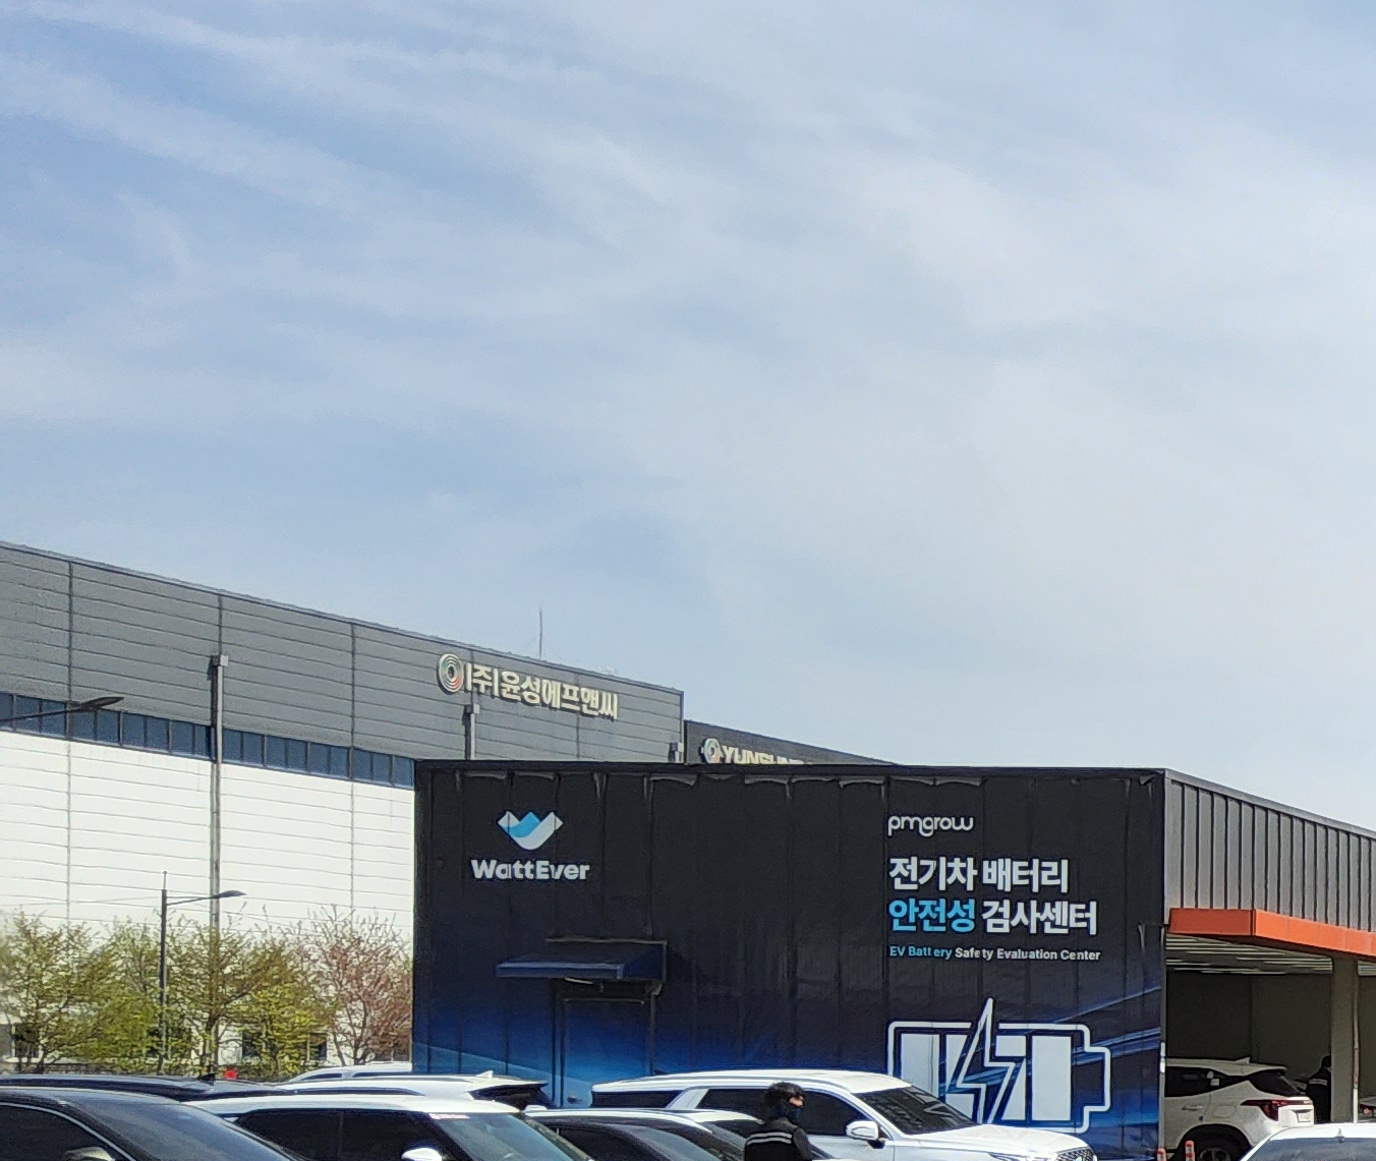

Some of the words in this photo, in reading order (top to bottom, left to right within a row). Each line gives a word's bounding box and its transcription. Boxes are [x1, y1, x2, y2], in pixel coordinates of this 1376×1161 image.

[888, 816, 974, 837] pmgrow
[471, 859, 590, 880] WattEver
[889, 856, 978, 891] 전기차
[982, 858, 1069, 893] 배터리
[889, 898, 976, 932] 안전성
[982, 900, 1098, 935] 검사센터
[889, 946, 906, 957] EV
[908, 946, 952, 961] Battery
[955, 947, 993, 961] Safety
[996, 948, 1058, 960] Evaluation
[1060, 949, 1101, 961] Center
